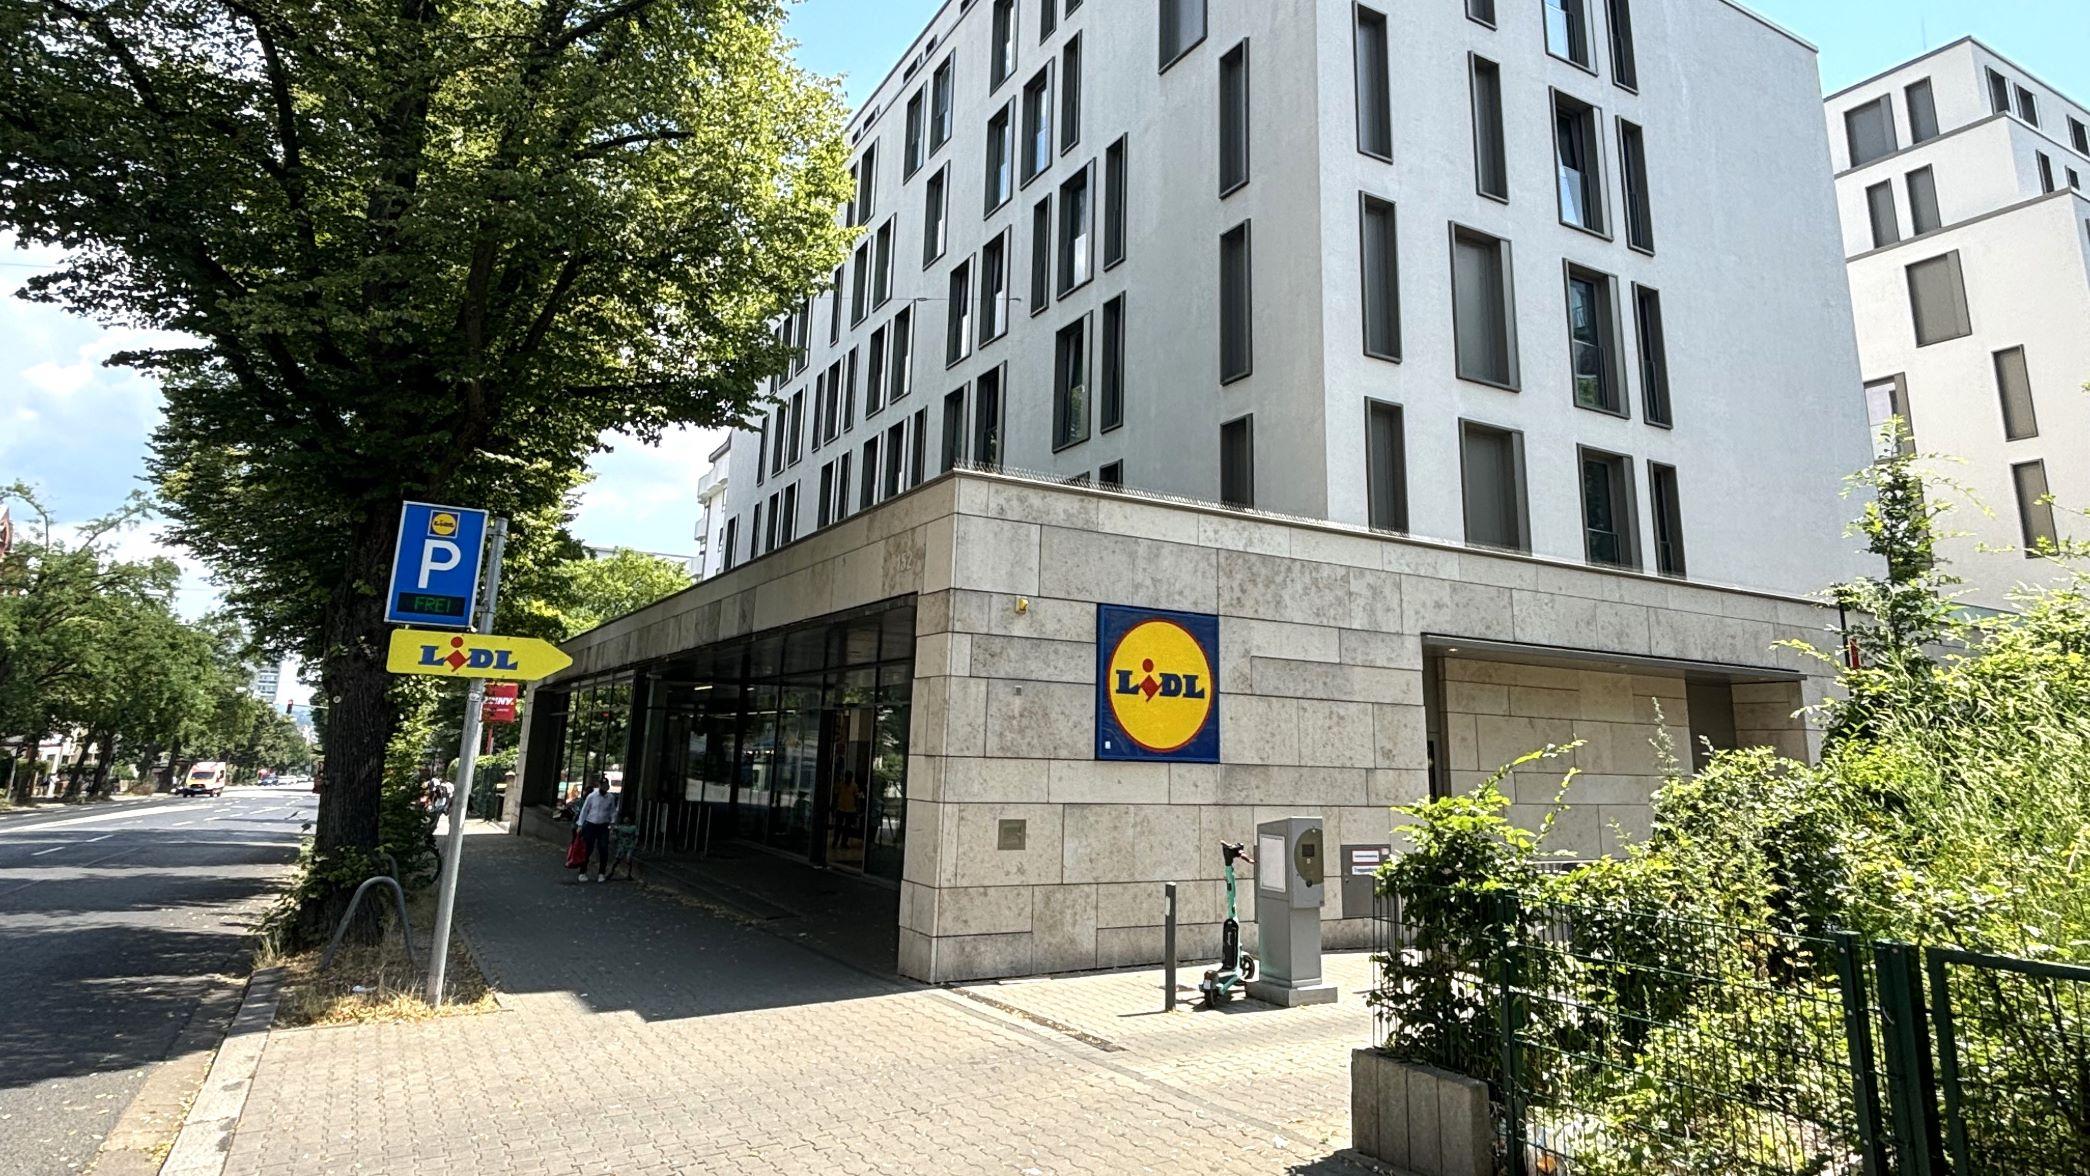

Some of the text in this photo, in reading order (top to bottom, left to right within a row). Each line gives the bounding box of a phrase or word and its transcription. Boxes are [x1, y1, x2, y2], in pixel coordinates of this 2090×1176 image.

[417, 539, 462, 589] P
[896, 551, 912, 571] 152
[414, 596, 451, 613] FREI
